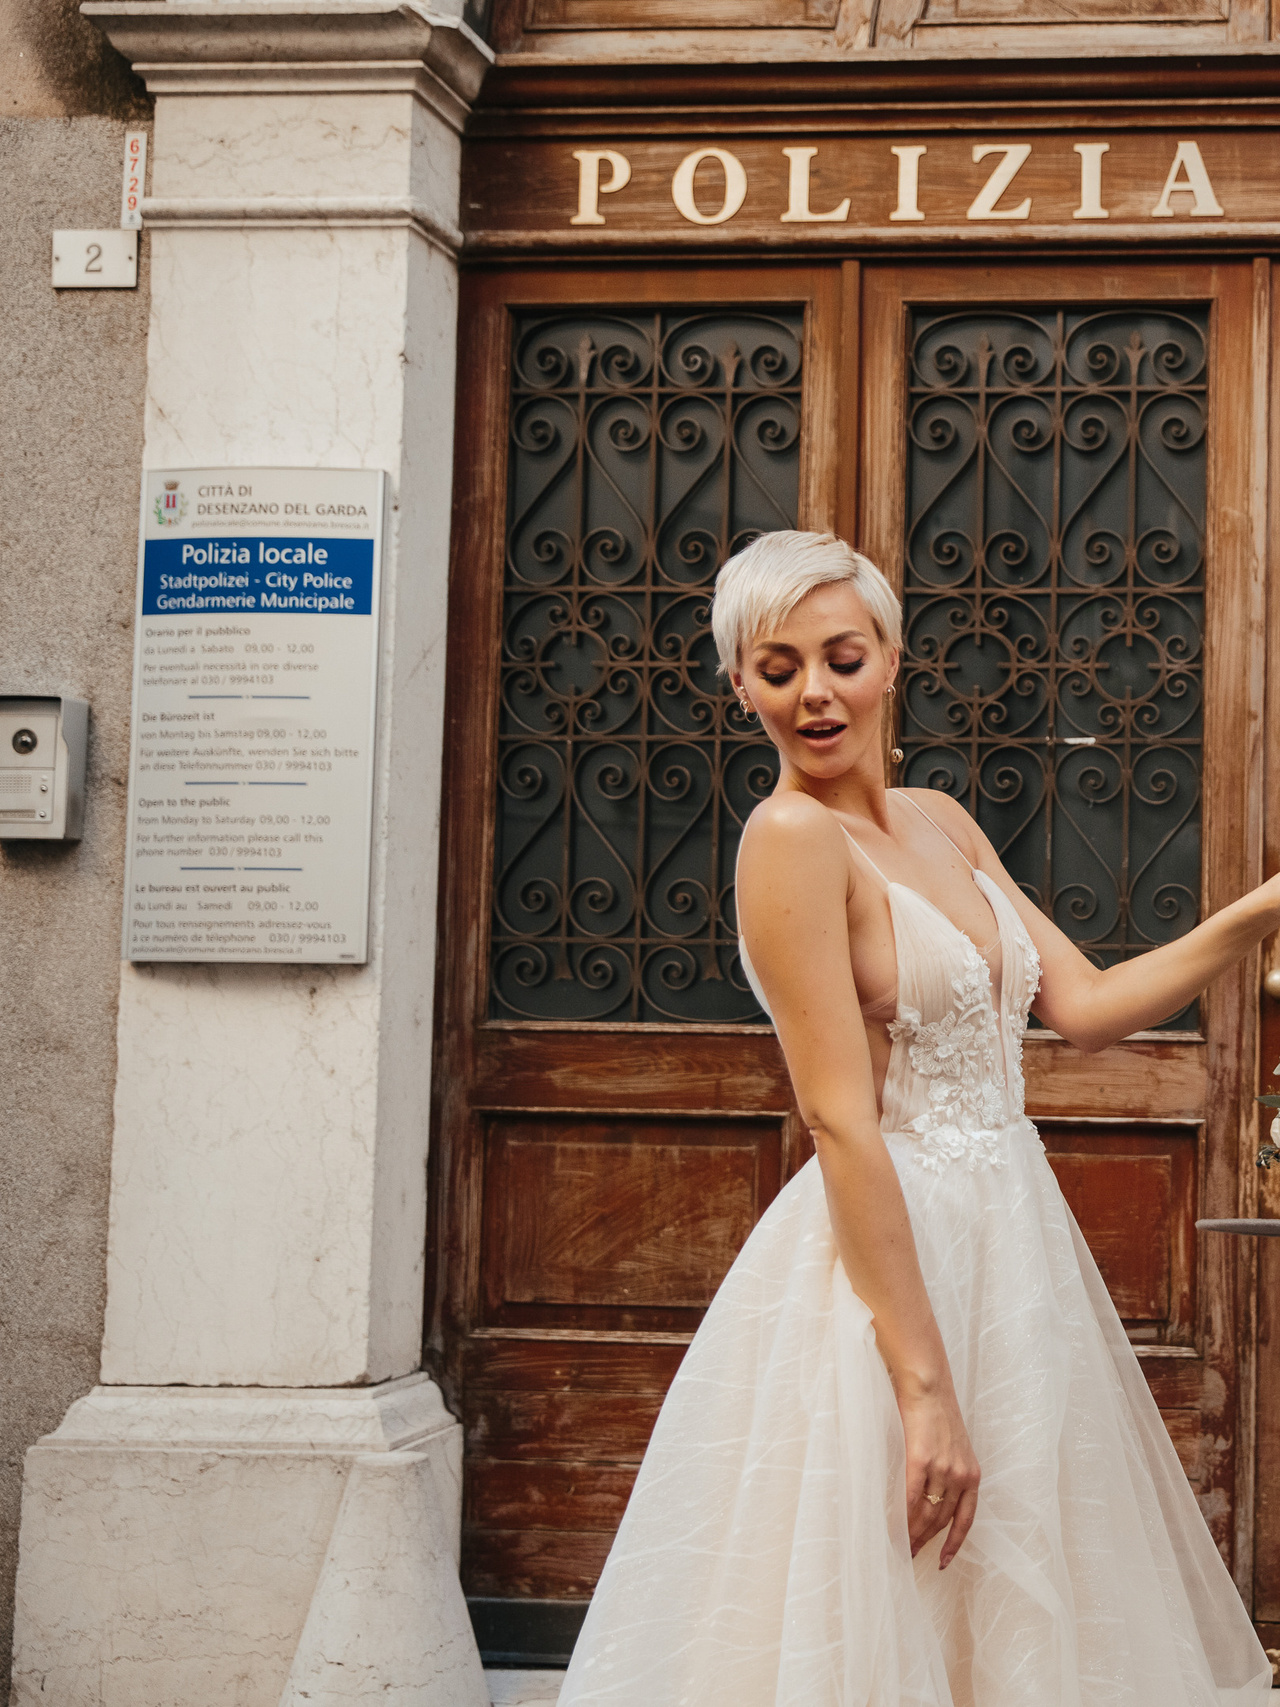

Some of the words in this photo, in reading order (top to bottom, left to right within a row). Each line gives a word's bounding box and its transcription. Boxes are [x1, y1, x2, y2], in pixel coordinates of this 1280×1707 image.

[127, 138, 140, 211] 6729
[570, 140, 1225, 226] POLIZIA
[84, 243, 103, 273] 2
[198, 484, 233, 497] CITTÀ
[238, 486, 252, 497] DI
[197, 503, 279, 516] DESENZANO
[284, 504, 310, 516] DEL
[316, 504, 368, 516] GARDA
[182, 543, 251, 565] Polizia
[259, 542, 328, 565] locale
[160, 572, 249, 592] Stadtpolizei
[265, 572, 298, 592] City
[303, 572, 353, 589] Police
[157, 593, 256, 610] Gendarmerie
[261, 592, 355, 612] Municipale
[145, 627, 175, 638] Orario
[177, 628, 193, 639] per
[196, 627, 202, 636] il
[205, 627, 251, 637] pubblico
[144, 645, 155, 655] da
[201, 644, 234, 654] Sabato
[143, 663, 156, 672] Per
[159, 662, 199, 672] eventuali
[203, 661, 246, 671] necessità
[250, 662, 259, 671] in
[263, 663, 279, 671] ore
[283, 661, 319, 671] diverse
[143, 676, 187, 686] telefonare
[190, 675, 199, 685] al
[202, 675, 220, 685] 030
[229, 675, 274, 685] 9994103
[142, 713, 157, 722] Die
[160, 712, 200, 721] Bürozeit
[202, 712, 215, 721] ist
[141, 732, 157, 740] von
[159, 730, 195, 741] Montag
[198, 730, 211, 739] bis
[214, 730, 255, 740] Samstag
[140, 747, 154, 758] Für
[157, 748, 190, 757] weitere
[248, 748, 289, 757] wenden
[293, 748, 307, 757] Sie
[310, 748, 331, 757] sich
[334, 748, 359, 758] bitte
[139, 763, 151, 772] an
[153, 761, 175, 771] diese
[179, 761, 253, 771] Telefonnummer
[255, 761, 275, 771] 030
[285, 761, 332, 772] 9994103
[138, 798, 164, 808] Open
[167, 798, 177, 807] to
[180, 798, 196, 807] the
[199, 797, 231, 808] public
[137, 816, 159, 825] from
[162, 815, 199, 827] Monday
[202, 816, 212, 825] to
[215, 815, 256, 827] Saturday
[136, 834, 150, 843] For
[153, 833, 185, 843] further
[187, 833, 245, 843] information
[248, 833, 280, 844] please
[283, 833, 301, 843] call
[304, 833, 324, 843] this
[136, 847, 164, 858] phone
[167, 847, 203, 857] number
[208, 847, 229, 857] 030
[236, 847, 282, 858] 9994103
[135, 884, 146, 893] Le
[148, 883, 182, 893] bureau
[185, 884, 200, 893] est
[203, 884, 237, 893] ouvert
[240, 885, 253, 893] au
[256, 883, 290, 895] public
[134, 902, 146, 911] du
[148, 902, 172, 911] Lundi
[175, 902, 188, 911] au
[197, 901, 232, 911] Samedi
[133, 919, 153, 928] Pour
[155, 920, 176, 928] tous
[178, 920, 255, 931] renseignements
[258, 919, 332, 929] adressez-vous
[140, 934, 149, 942] ce
[152, 931, 188, 942] numéro
[191, 933, 202, 942] de
[269, 932, 290, 943] 030
[299, 933, 347, 944] 9994103
